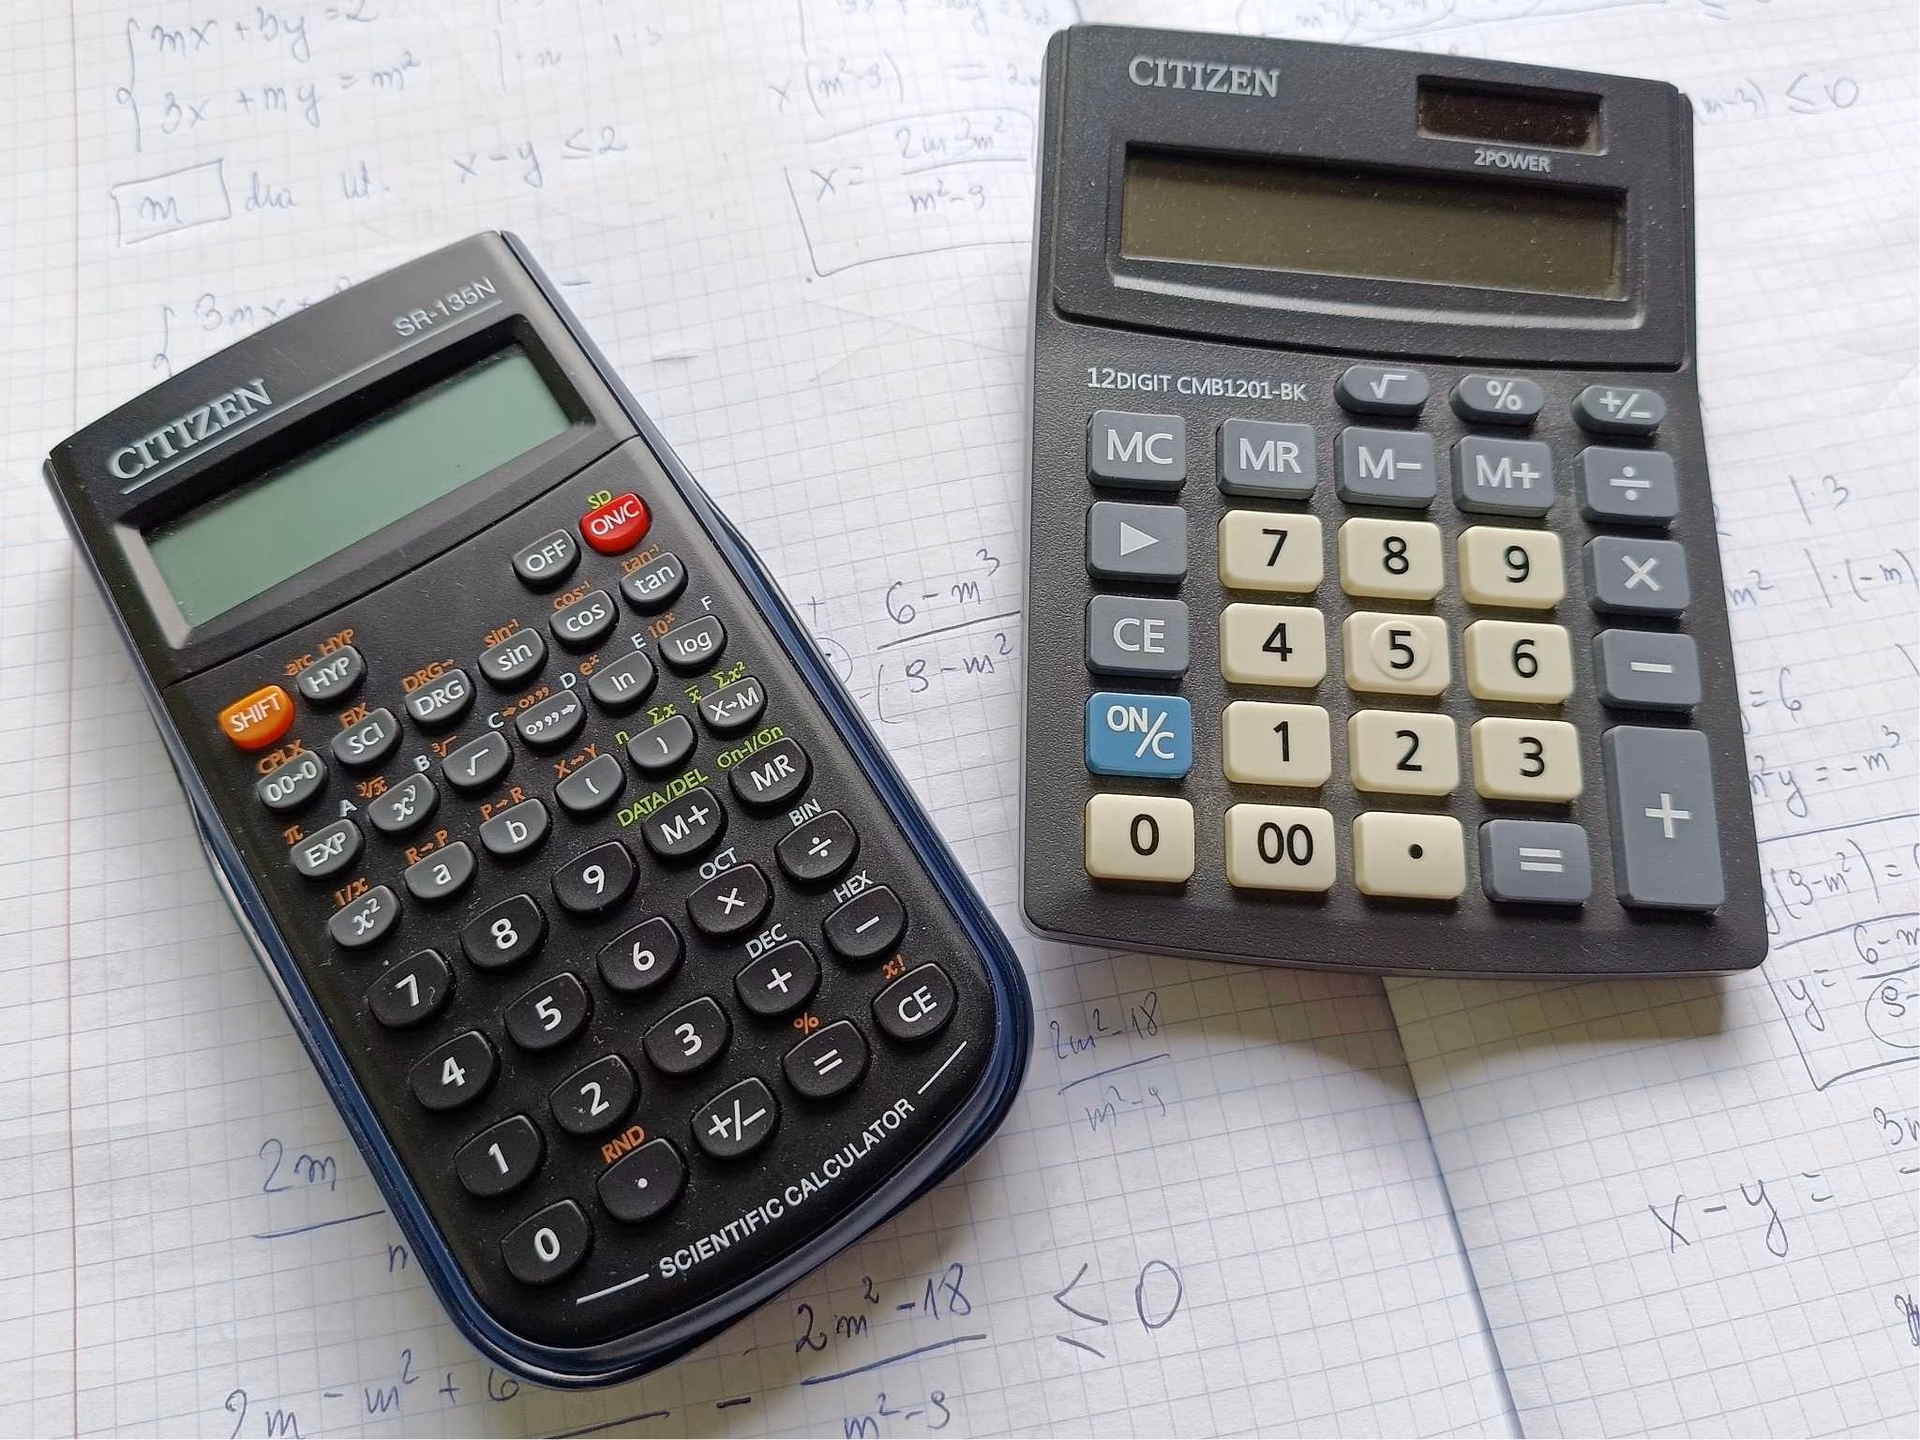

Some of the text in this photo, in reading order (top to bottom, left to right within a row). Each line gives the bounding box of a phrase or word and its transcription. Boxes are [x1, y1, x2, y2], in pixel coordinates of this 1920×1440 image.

[1127, 55, 1281, 98] CITIZEN
[1473, 150, 1552, 174] 2POWER
[392, 277, 497, 337] SR-135N
[1087, 367, 1308, 402] 12DIGIT CMB1201-BK
[1486, 380, 1522, 411] %
[108, 379, 273, 479] CITIZEN
[1107, 429, 1173, 465] MC
[1239, 437, 1302, 474] MR
[1475, 454, 1540, 490] M+
[588, 490, 612, 510] SD
[591, 500, 640, 536] ON/C
[527, 539, 567, 572] OFF
[1261, 528, 1288, 567] 7
[1382, 536, 1410, 575] 8
[1503, 545, 1530, 583] 9
[634, 565, 675, 595] tan
[566, 603, 606, 632] cos
[700, 596, 713, 611] F
[319, 628, 355, 657] HYP
[631, 633, 647, 650] E
[675, 631, 713, 656] log
[1113, 617, 1165, 653] CE
[1262, 622, 1293, 662] 4
[1388, 629, 1415, 670] 5
[306, 656, 350, 693] HYP
[498, 643, 533, 672] sin
[1511, 638, 1539, 679] 6
[414, 679, 465, 716] DRG
[559, 672, 577, 689] D
[230, 692, 282, 733] SHIFT
[340, 702, 371, 729] FIX
[488, 712, 504, 729] C
[348, 722, 385, 754] SCI
[614, 730, 630, 746] n
[1273, 720, 1290, 762] 1
[1395, 729, 1423, 772] 2
[257, 739, 304, 775] CPLX
[413, 755, 431, 772] B
[750, 753, 796, 792] MR
[1518, 736, 1545, 778] 3
[339, 799, 358, 817] A
[616, 768, 709, 827] DATA/DEL
[788, 798, 822, 827] BIN
[505, 820, 528, 844] b
[660, 804, 710, 845] M+
[1129, 813, 1160, 856] 0
[304, 831, 347, 869] EXP
[1257, 821, 1314, 866] 00
[432, 863, 452, 885] a
[582, 864, 606, 894] 9
[698, 847, 738, 881] OCT
[832, 870, 874, 904] HEX
[490, 918, 519, 950] 8
[745, 923, 788, 959] DEC
[632, 941, 656, 971] 6
[395, 973, 420, 1007] 7
[898, 985, 938, 1023] CE
[535, 995, 562, 1031] 5
[793, 1012, 820, 1035] %
[674, 1022, 703, 1057] 3
[441, 1056, 466, 1087] 4
[580, 1081, 610, 1117] 2
[487, 1142, 510, 1175] 1
[601, 1125, 645, 1164] RND
[659, 1098, 915, 1279] SCIENTIFIC CALCULATOR
[534, 1227, 561, 1263] 0
